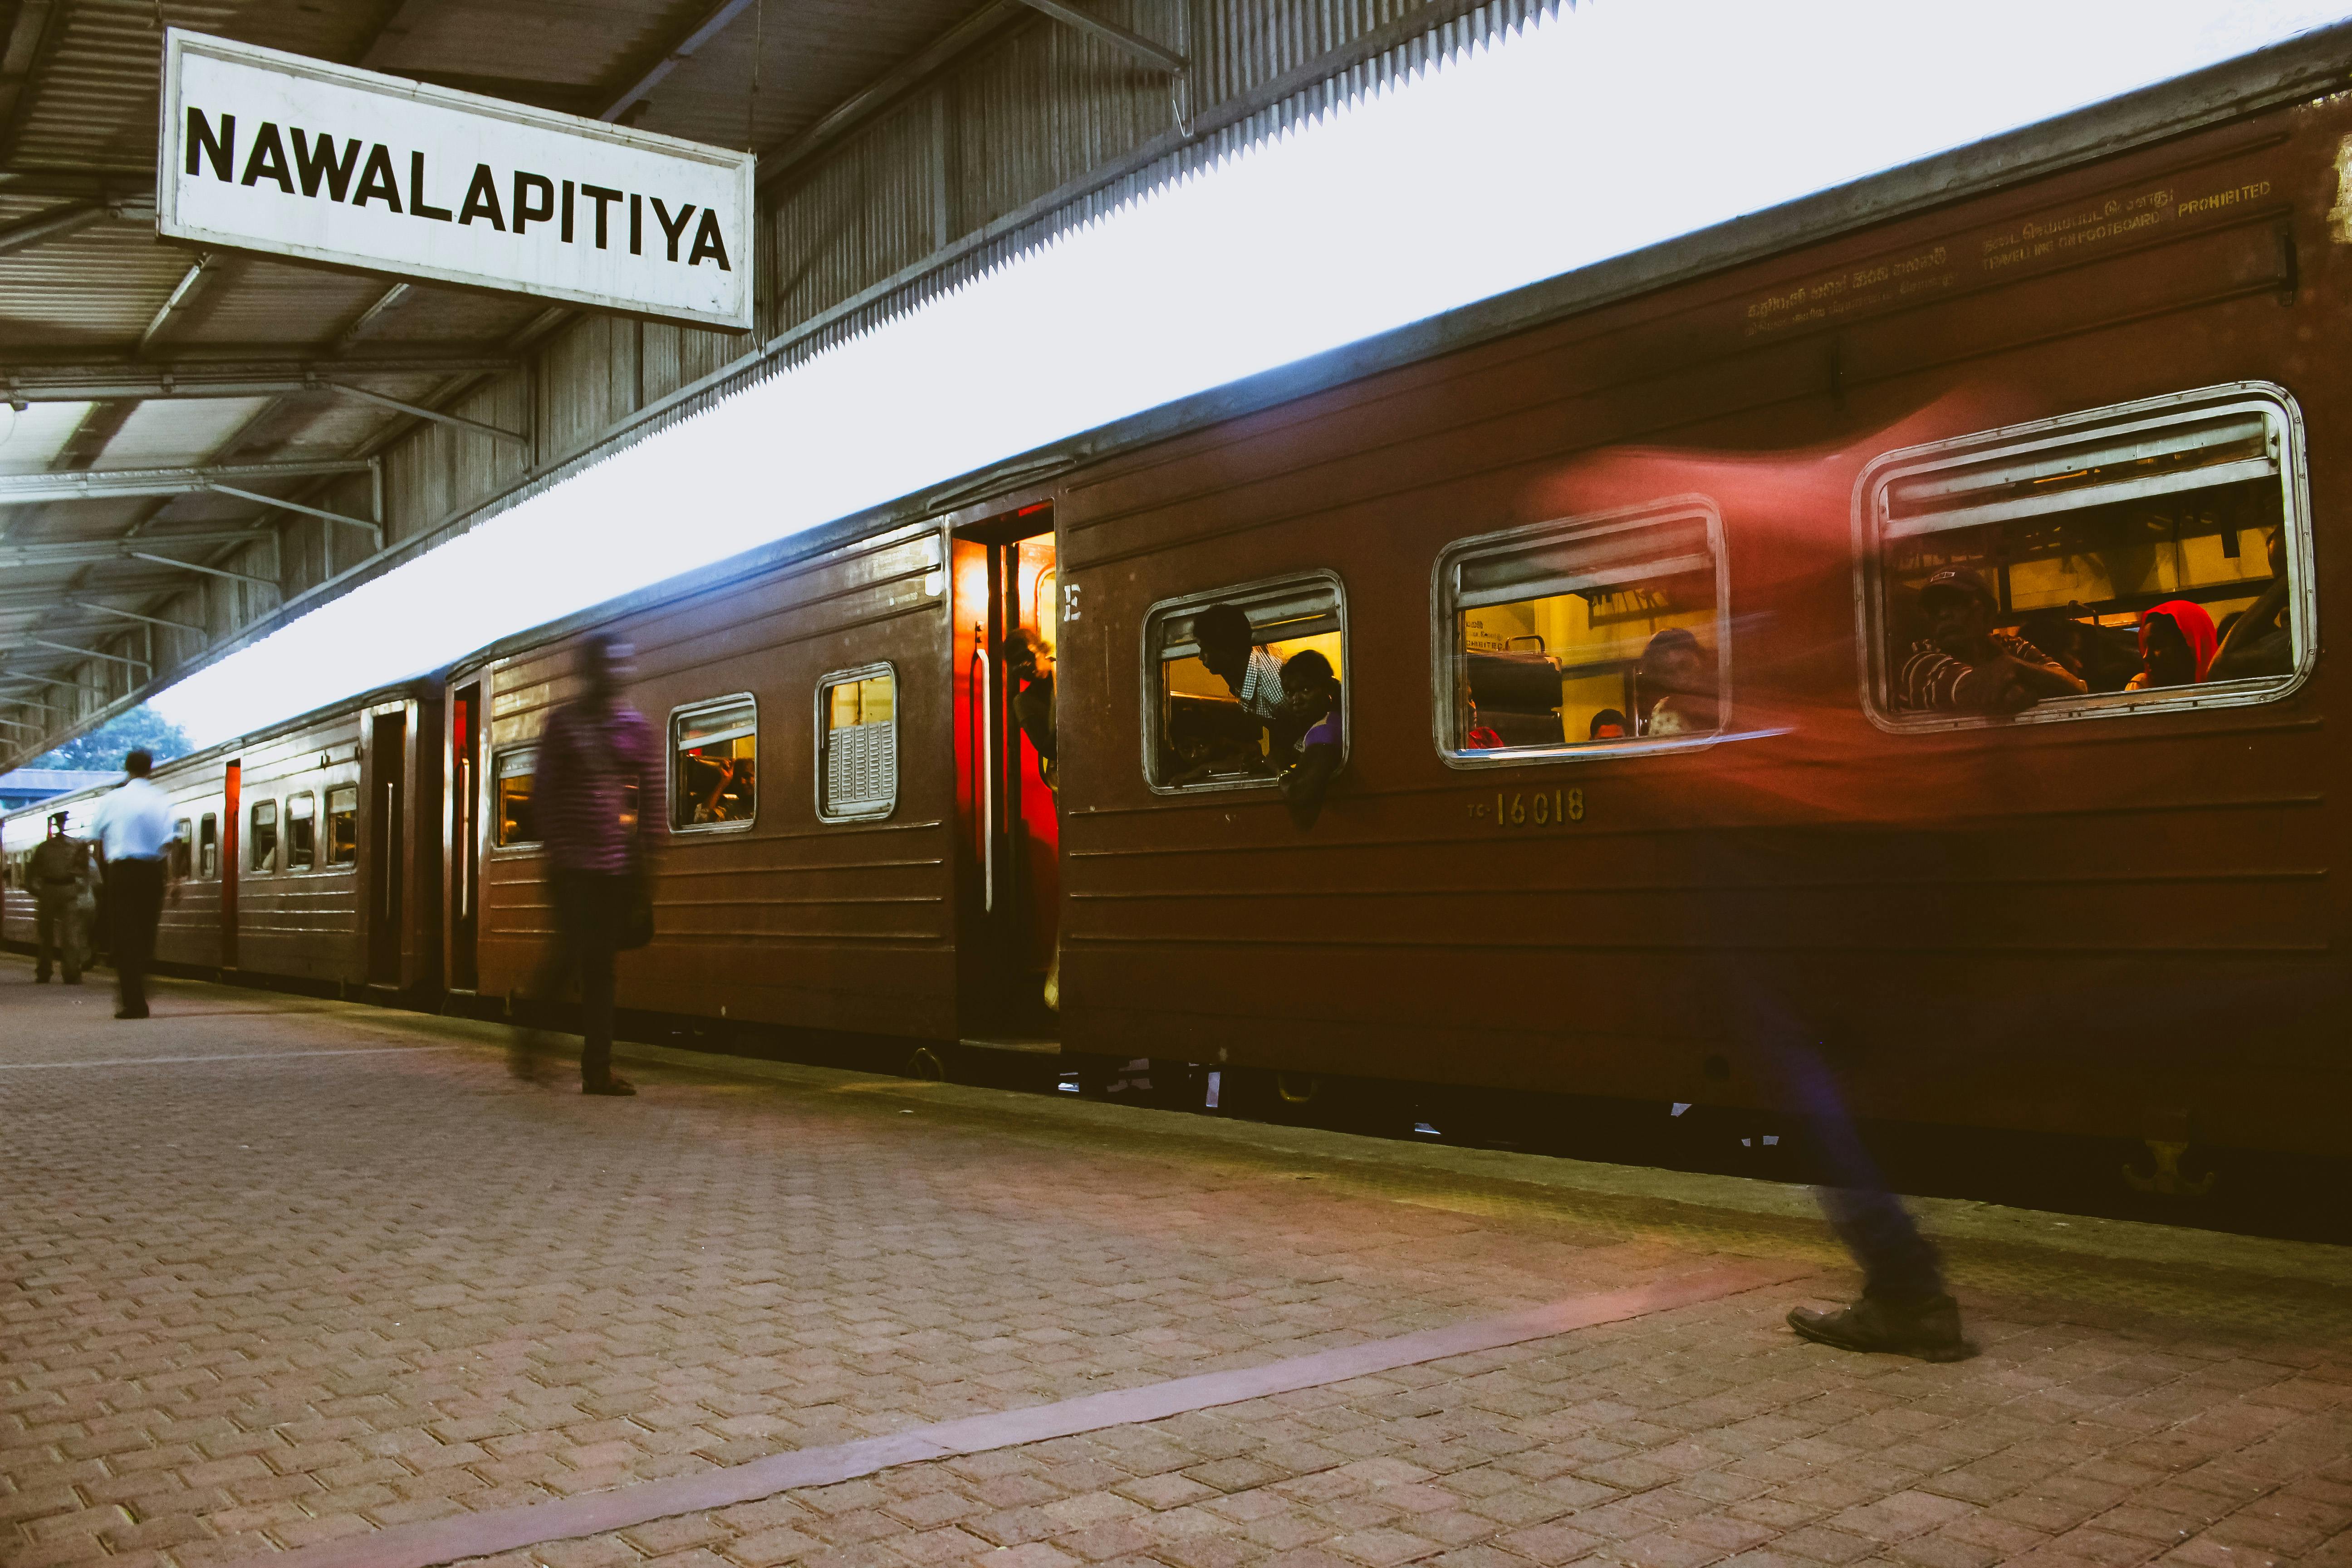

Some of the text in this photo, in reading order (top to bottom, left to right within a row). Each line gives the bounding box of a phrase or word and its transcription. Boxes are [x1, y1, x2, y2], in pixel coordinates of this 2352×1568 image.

[185, 106, 731, 271] NAWALAPITIYA
[2059, 235, 2076, 247] ON
[2078, 211, 2160, 244] FOOTBOARD
[2178, 181, 2271, 217] PROHIBITED
[1063, 584, 1081, 622] E
[1498, 787, 1584, 825] 16018
